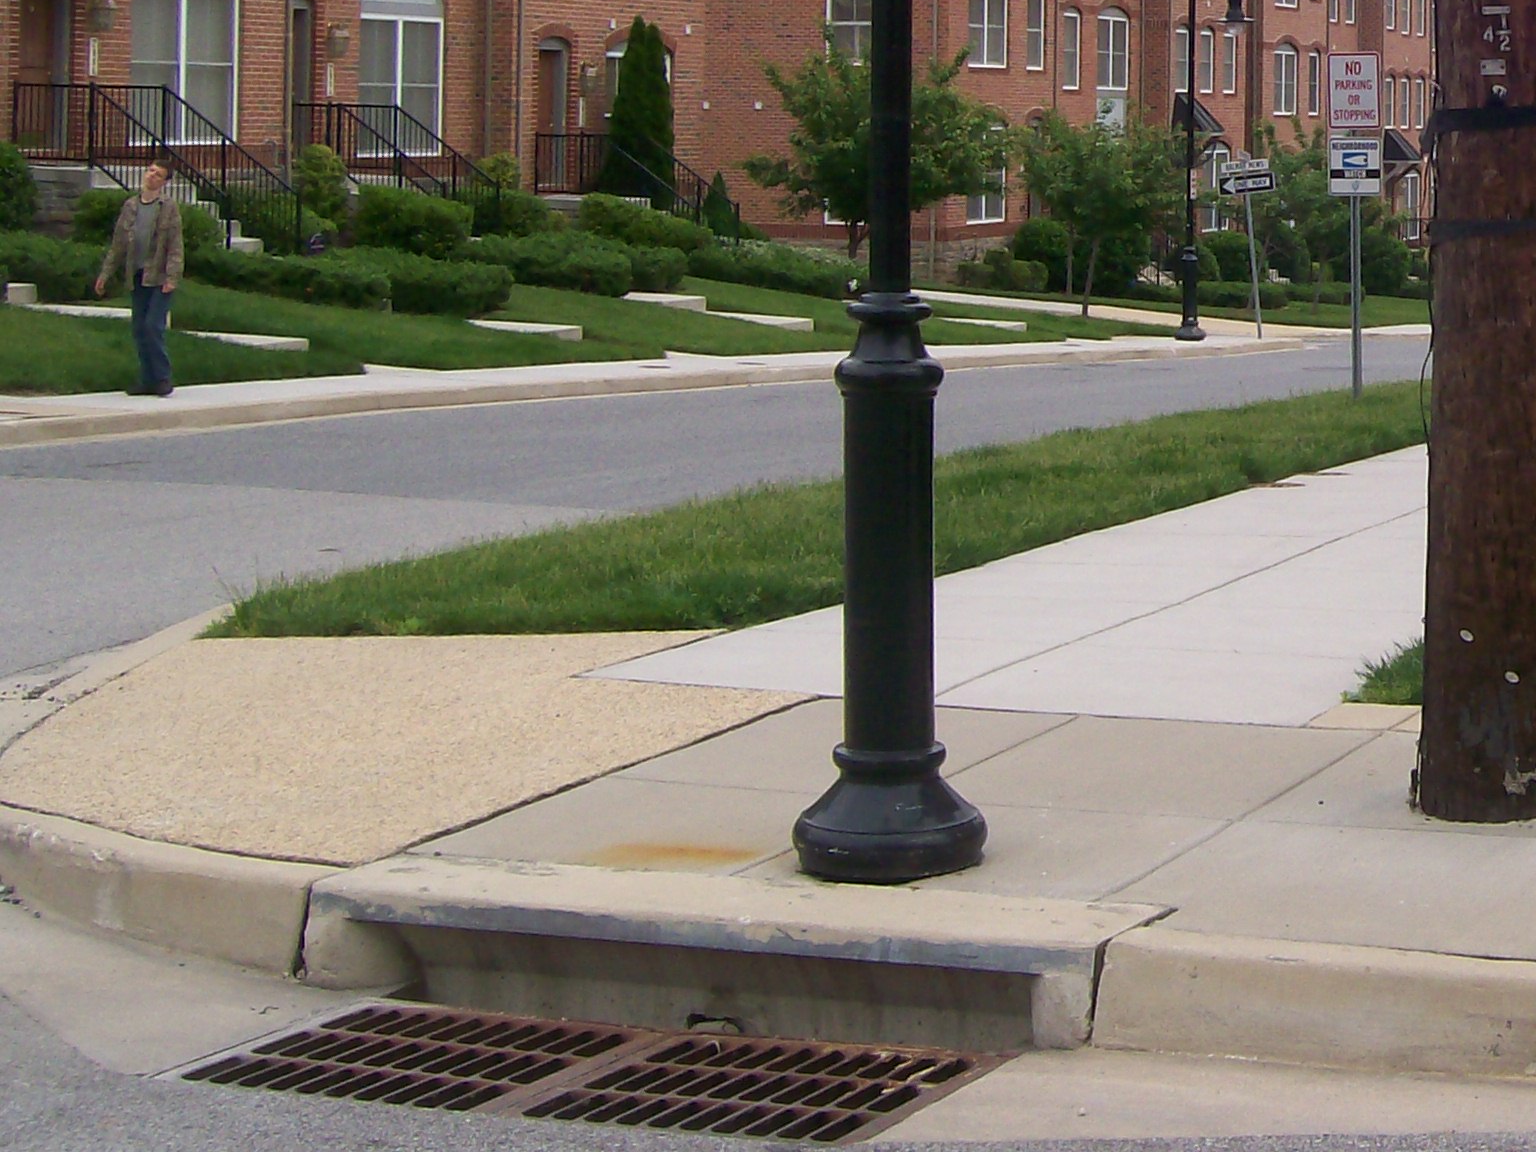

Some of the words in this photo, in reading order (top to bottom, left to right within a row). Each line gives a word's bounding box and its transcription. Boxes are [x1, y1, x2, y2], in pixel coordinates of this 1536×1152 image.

[1345, 61, 1362, 76] NO
[1334, 79, 1373, 91] PARKING
[1347, 94, 1361, 106] OR
[1333, 109, 1376, 121] STOPPING
